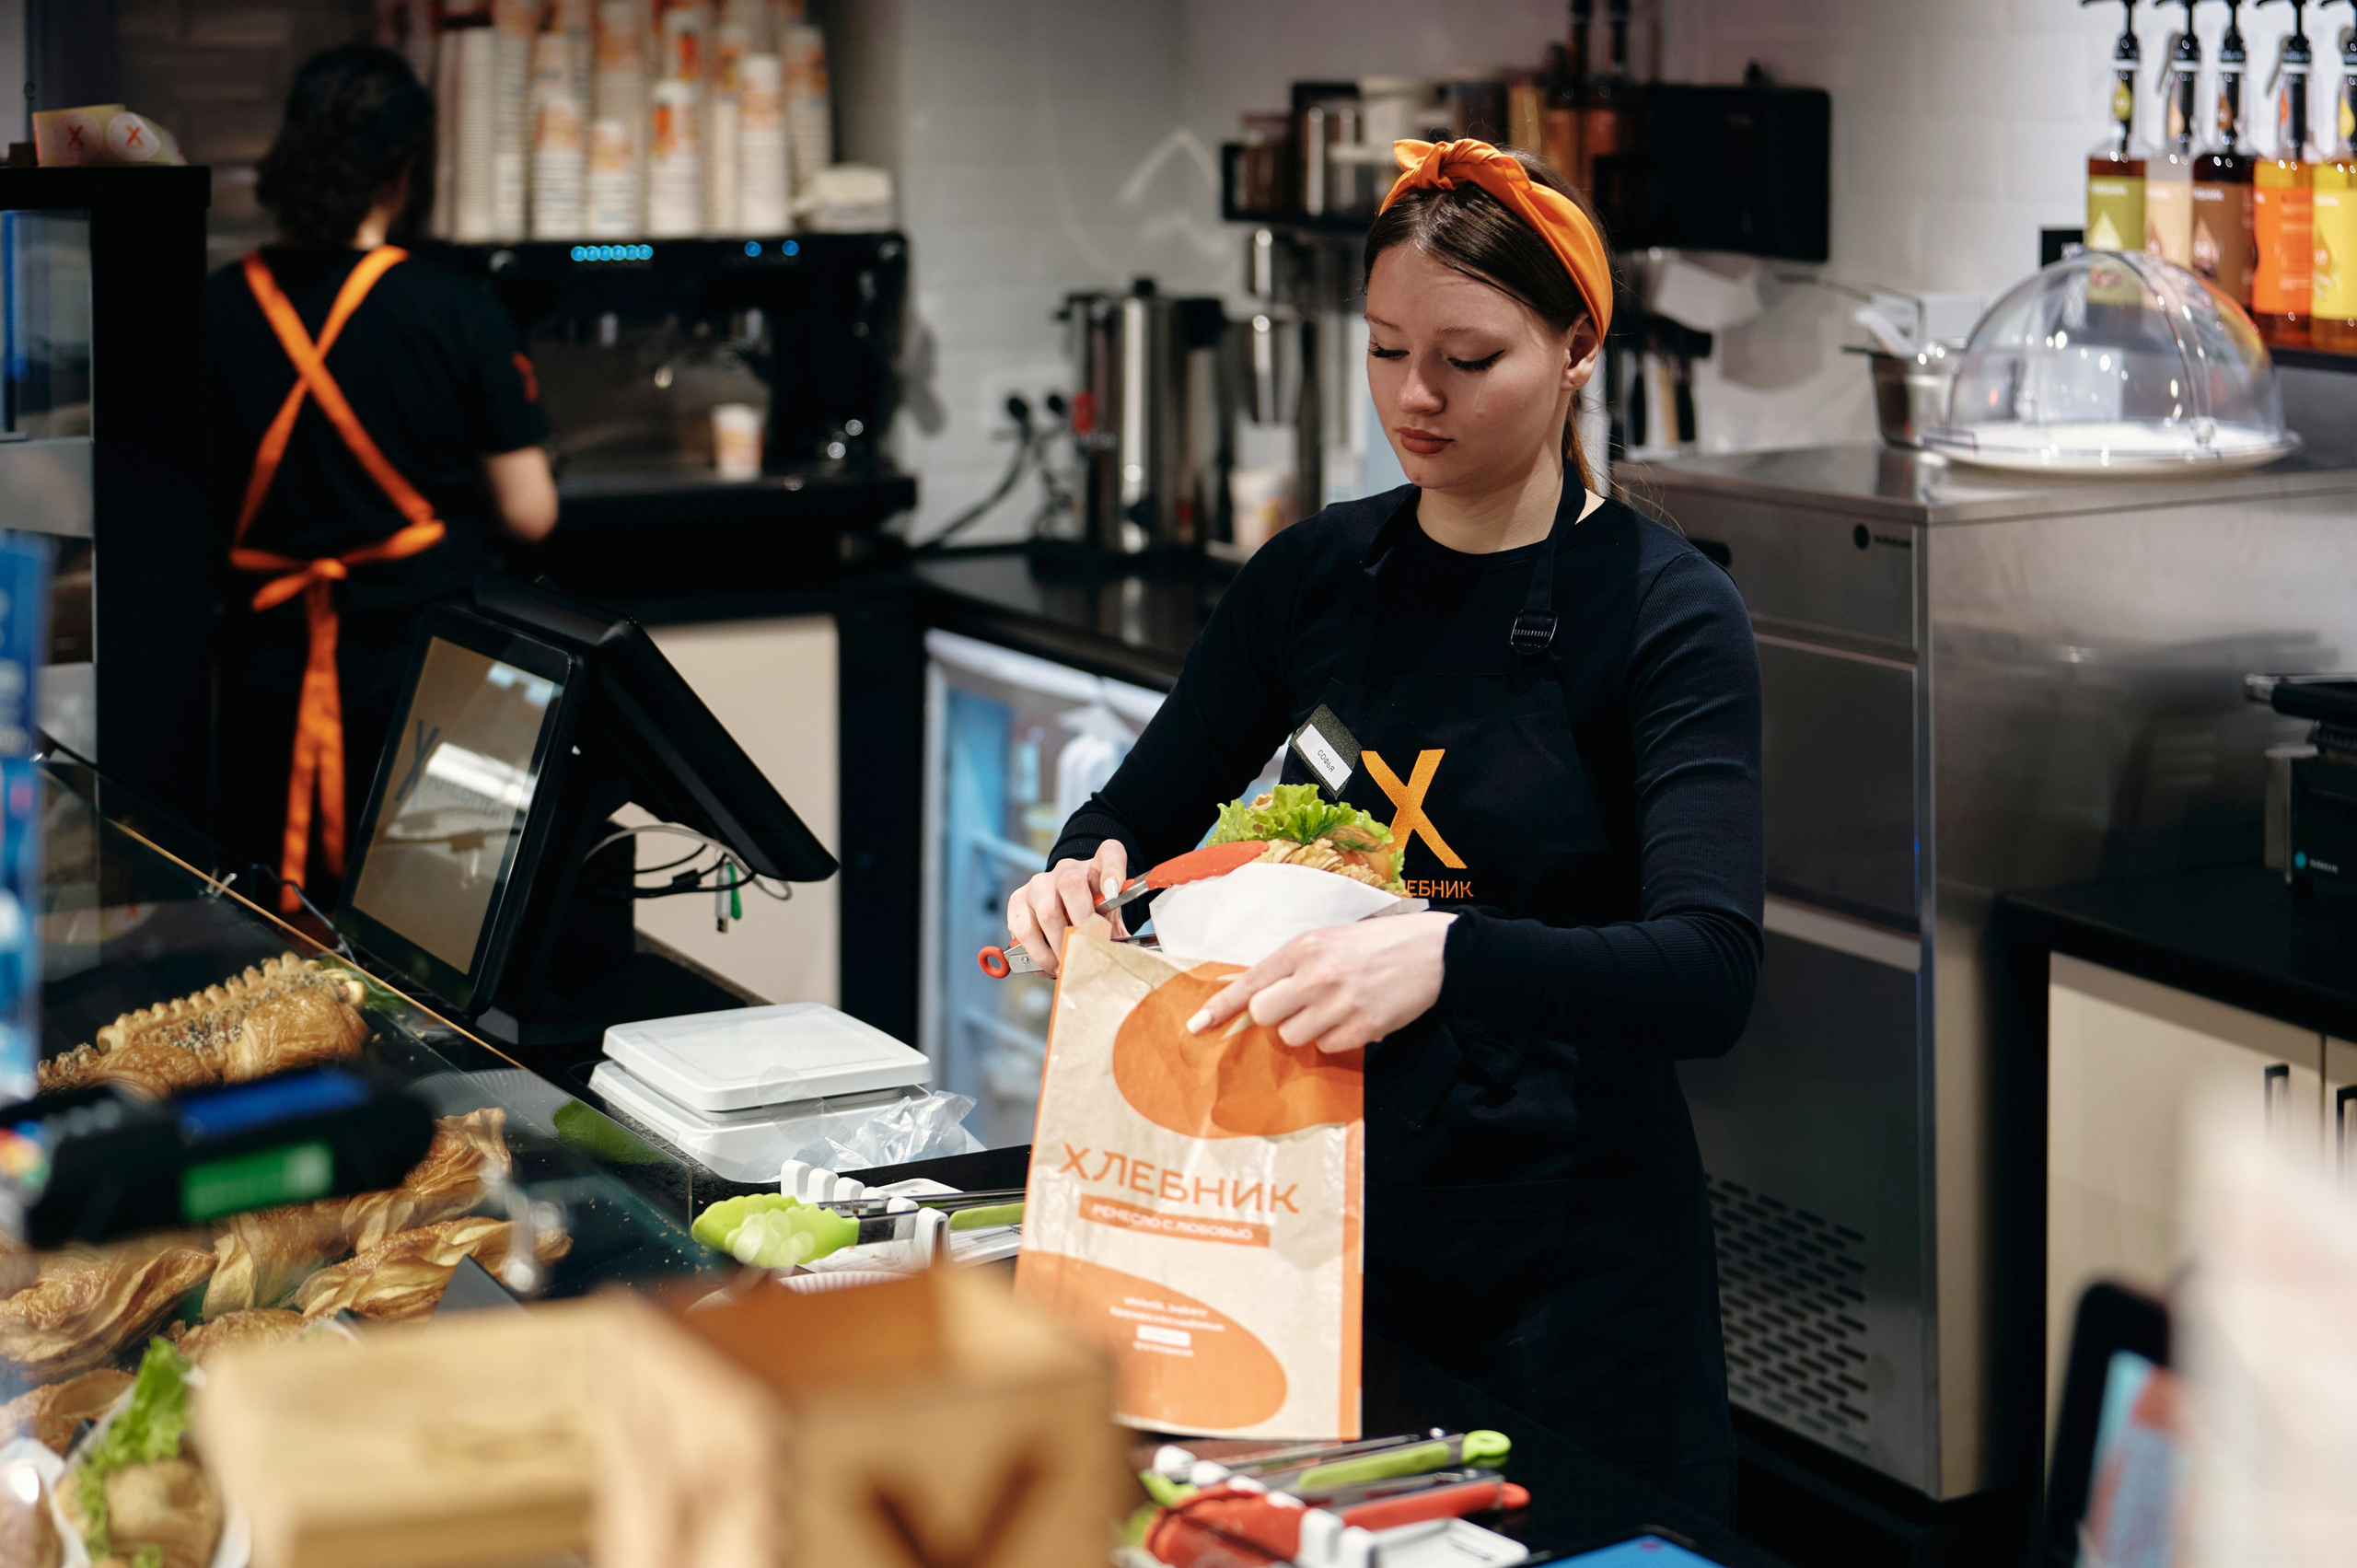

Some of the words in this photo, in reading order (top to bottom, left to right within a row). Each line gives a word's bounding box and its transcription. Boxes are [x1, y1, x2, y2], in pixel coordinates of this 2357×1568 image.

[1317, 749, 1336, 772] СОФЬЯ
[1404, 879, 1474, 899] ЕБНИК
[1057, 1142, 1300, 1214] ХЛЕБНИК
[1092, 1202, 1161, 1230] РЕМЕСЛО
[1162, 1219, 1174, 1231] С
[1175, 1221, 1254, 1240] ЛЮБОВЬЮ
